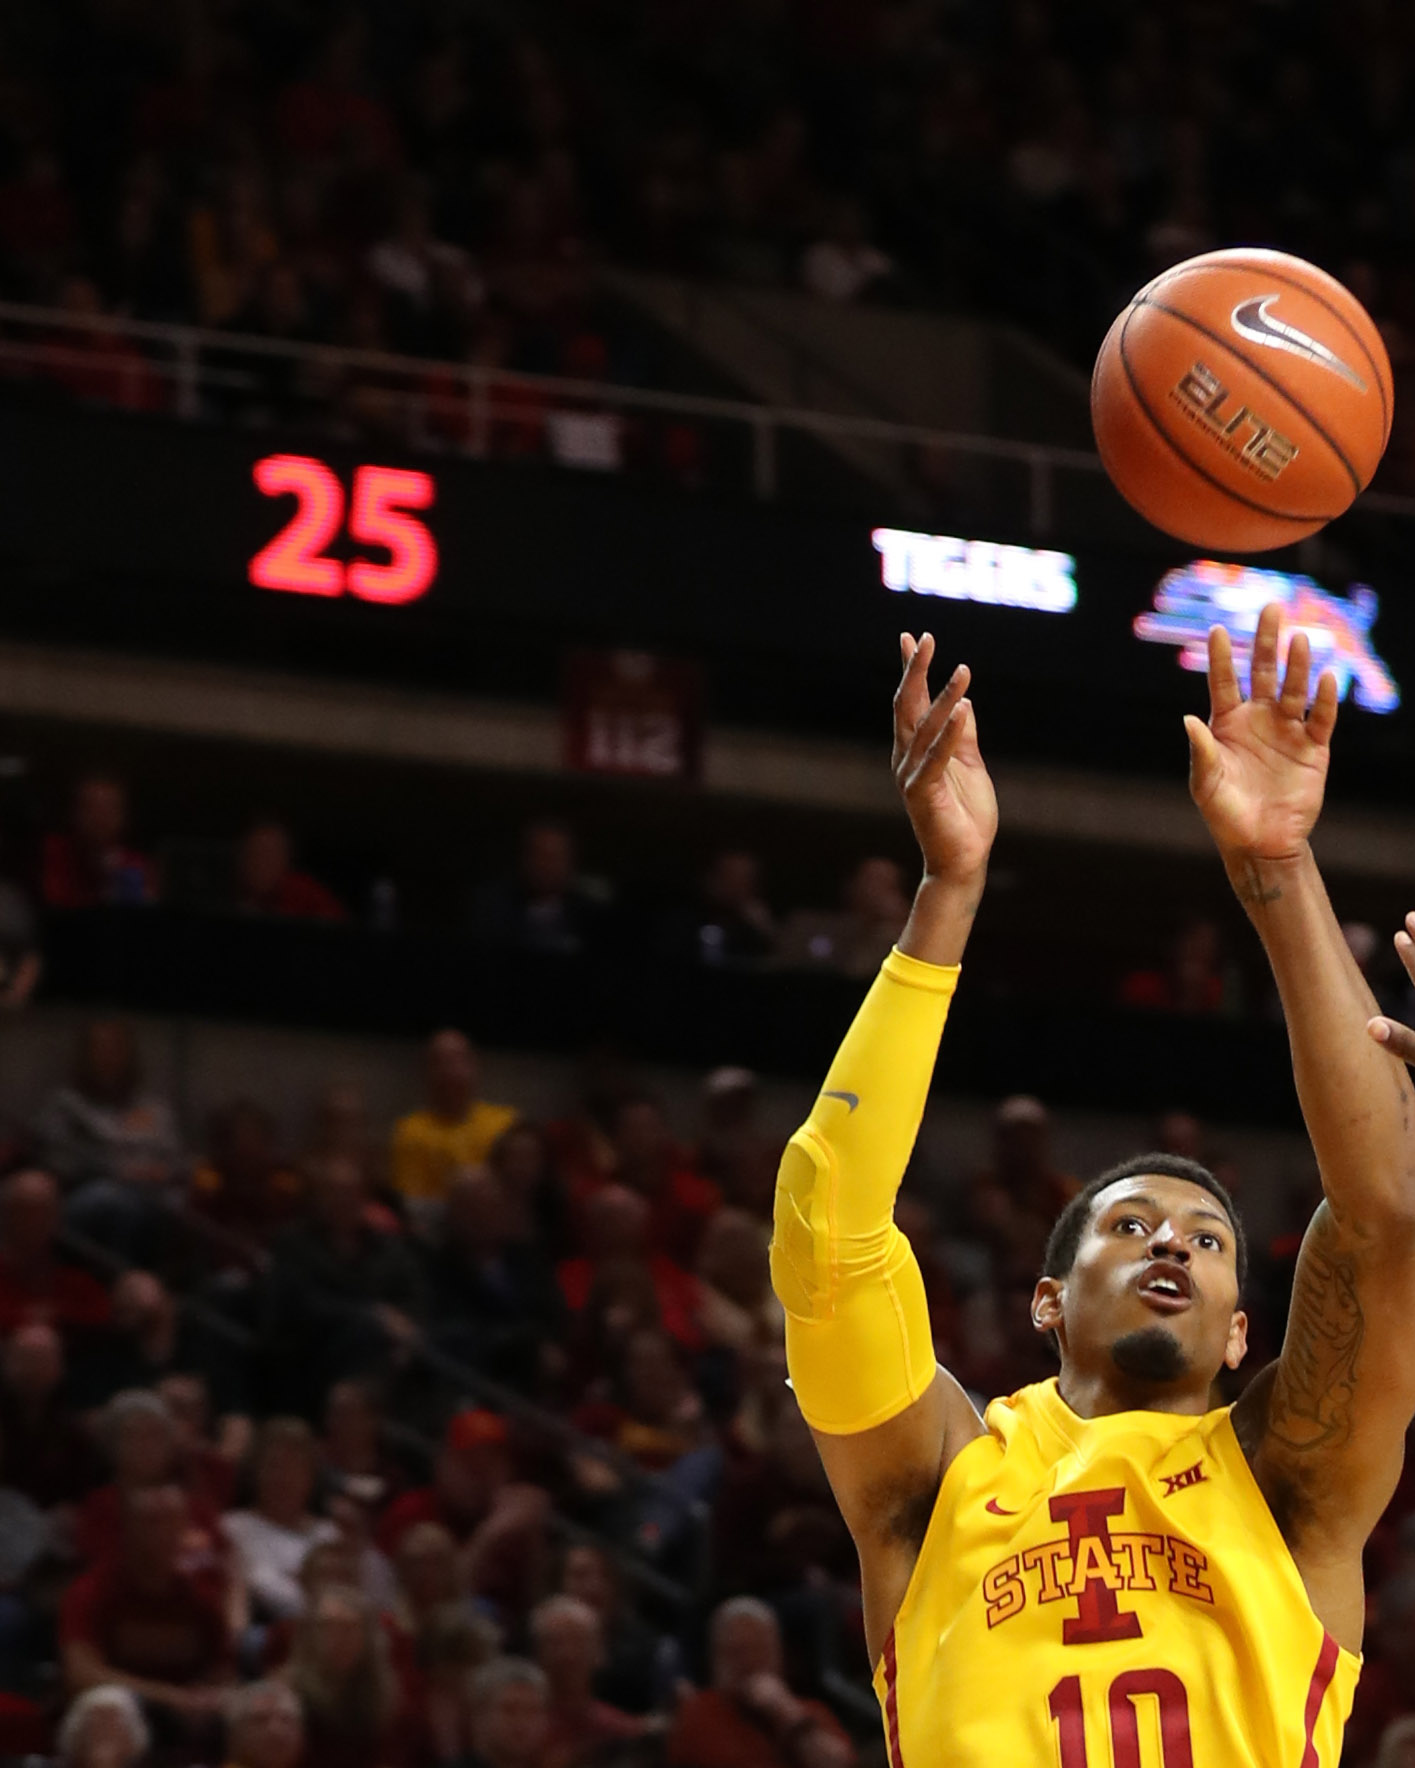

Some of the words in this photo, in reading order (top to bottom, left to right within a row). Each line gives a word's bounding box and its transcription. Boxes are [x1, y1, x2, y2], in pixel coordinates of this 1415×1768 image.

[1173, 360, 1299, 479] ELITE
[248, 454, 438, 605] 25
[872, 528, 1078, 612] TIGERS
[983, 1533, 1214, 1630] STATE
